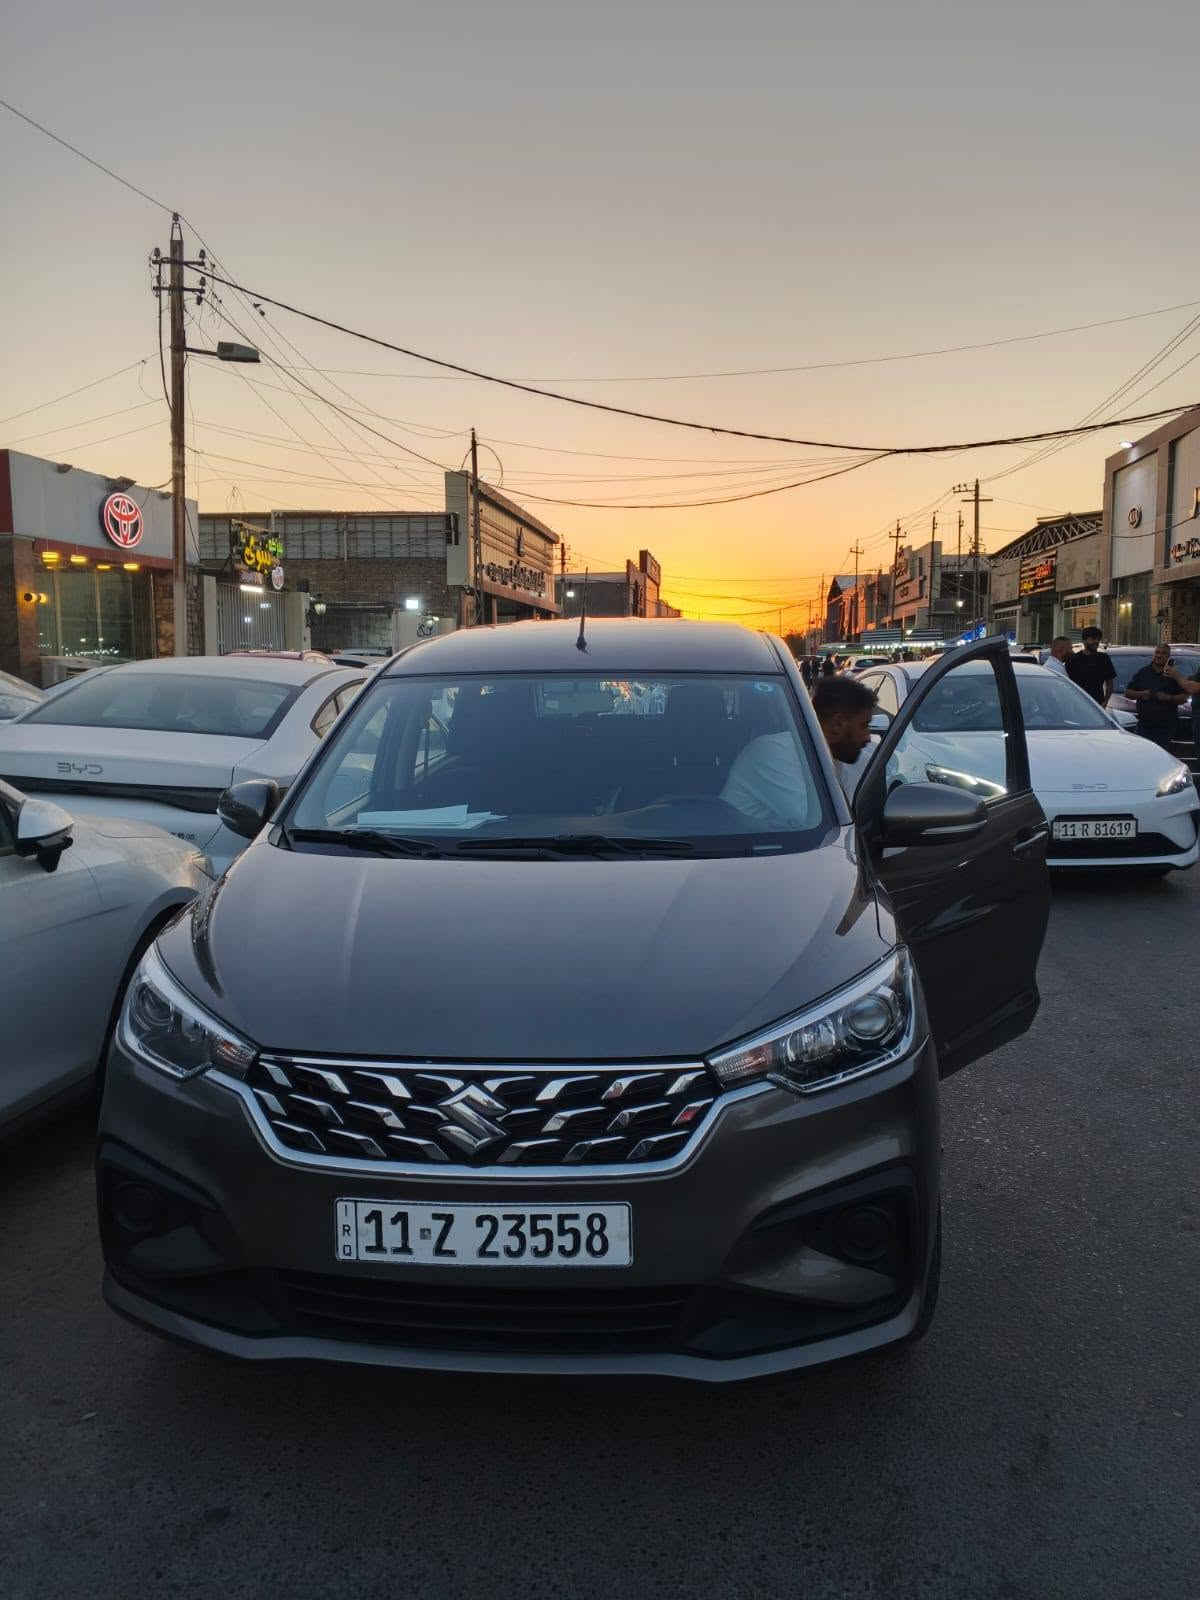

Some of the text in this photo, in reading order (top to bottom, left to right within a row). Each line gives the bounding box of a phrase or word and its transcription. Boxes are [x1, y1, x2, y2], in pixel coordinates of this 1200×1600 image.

[56, 762, 104, 775] BYD
[1061, 823, 1077, 837] 11
[1082, 823, 1090, 837] R
[1094, 822, 1131, 837] 81619
[364, 1209, 609, 1259] 11 Z 23558
